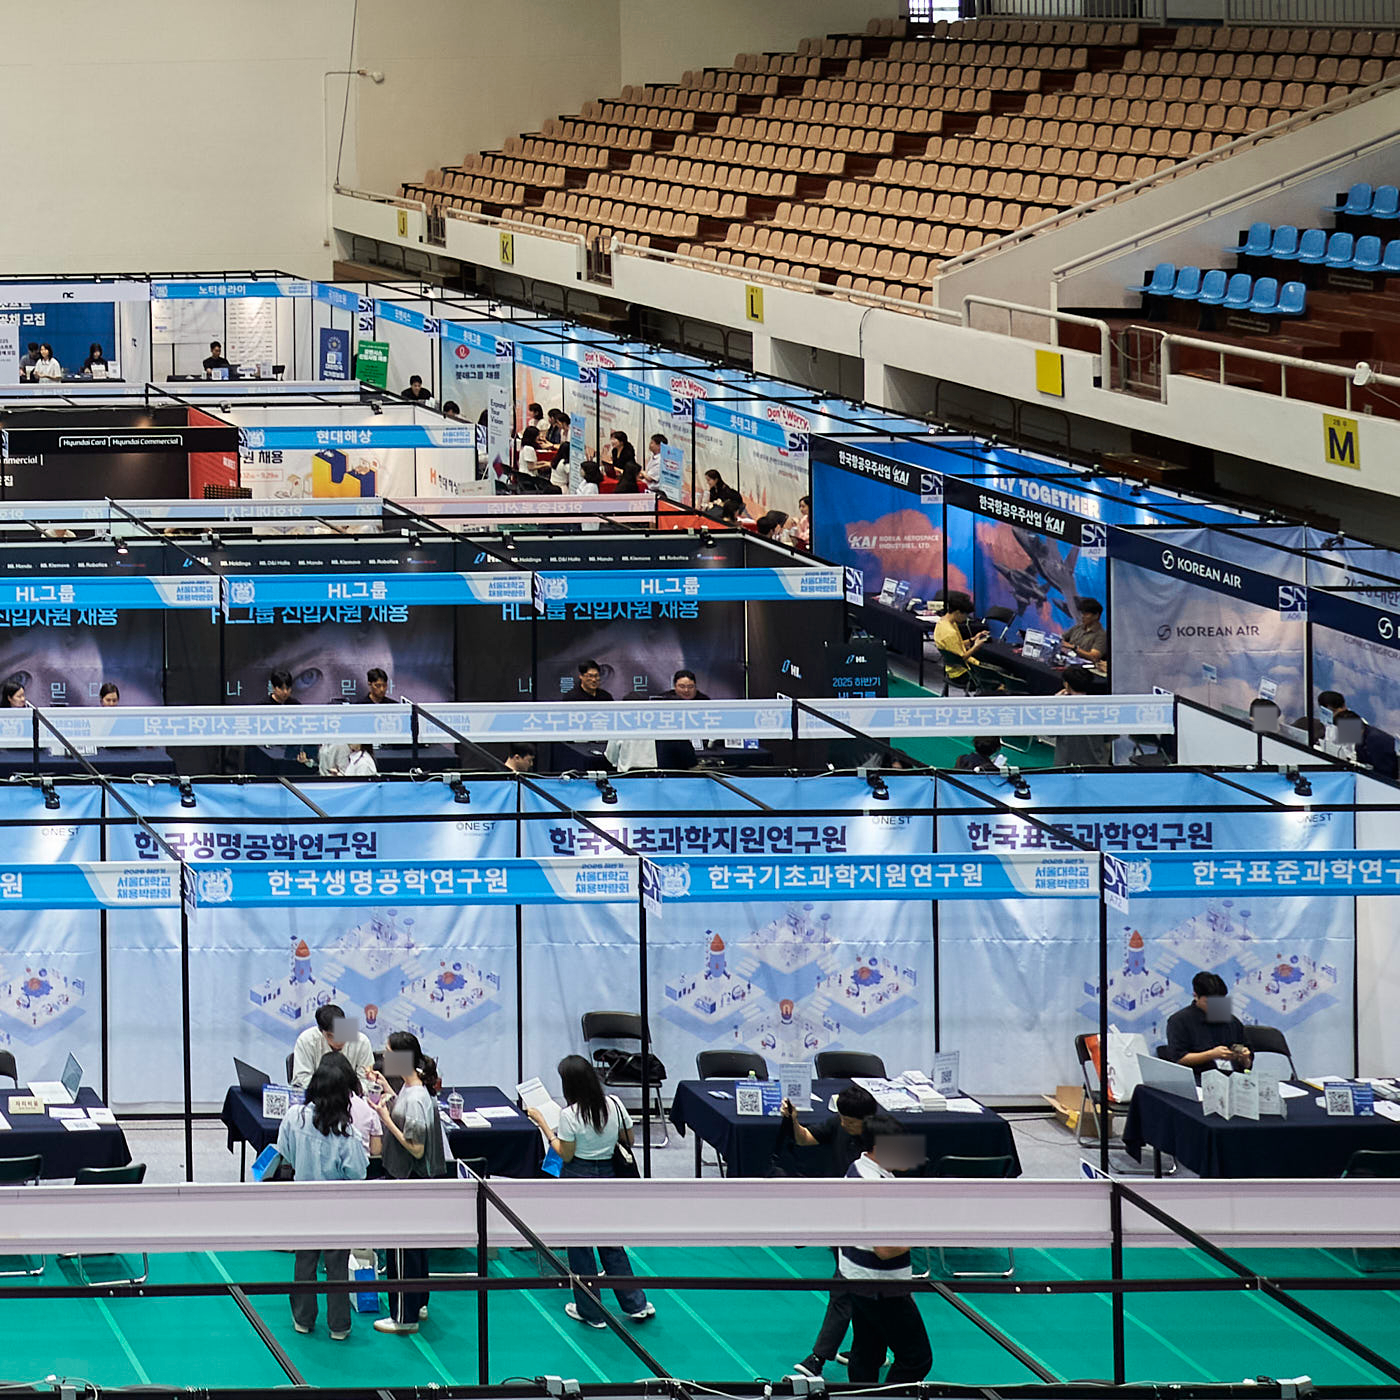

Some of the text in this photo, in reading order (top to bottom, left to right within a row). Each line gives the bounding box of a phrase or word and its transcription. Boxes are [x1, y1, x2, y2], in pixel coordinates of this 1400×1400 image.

[501, 240, 512, 262] K
[750, 292, 759, 319] L
[316, 430, 372, 444] 현대해상
[1331, 430, 1355, 464] M
[838, 450, 910, 485] 한국항공우주산업 KAI
[1019, 478, 1101, 518] TOGETHER
[979, 495, 1065, 533] 한국항공우주산업 KAI
[1177, 557, 1242, 588] KOREAN AIR
[15, 585, 75, 603] HL그룹
[328, 582, 388, 600] HL그룹
[1177, 624, 1260, 638] KOREAN AIR
[135, 831, 378, 861] 한국생명공학연구원
[268, 868, 508, 894] 한국생명공학연구원
[708, 862, 984, 890] 한국기초과학지원연구원
